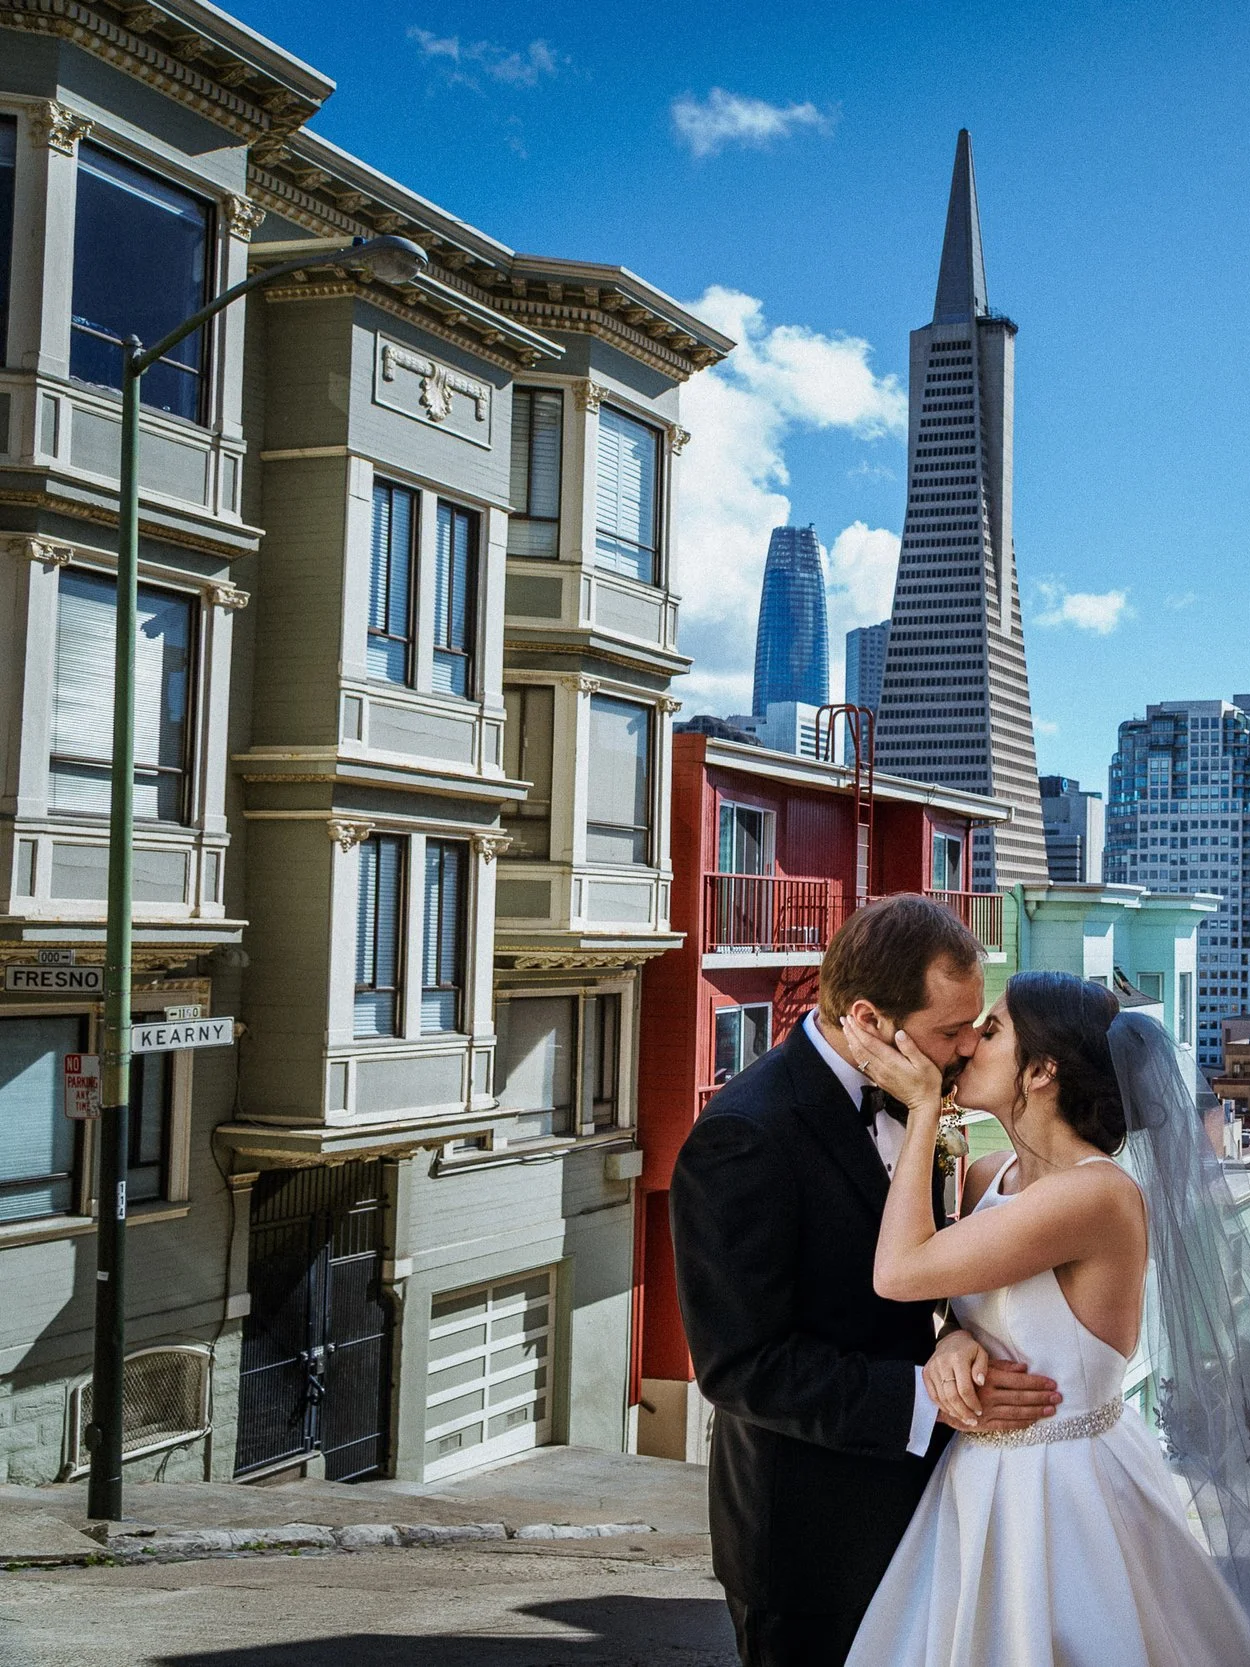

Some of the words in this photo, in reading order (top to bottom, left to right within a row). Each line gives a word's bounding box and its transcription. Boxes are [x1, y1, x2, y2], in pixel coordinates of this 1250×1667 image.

[41, 952, 60, 962] 000
[13, 971, 99, 988] FRESNO
[141, 1024, 224, 1047] KEARNY
[67, 1057, 80, 1072] NO
[67, 1076, 98, 1089] PARKING
